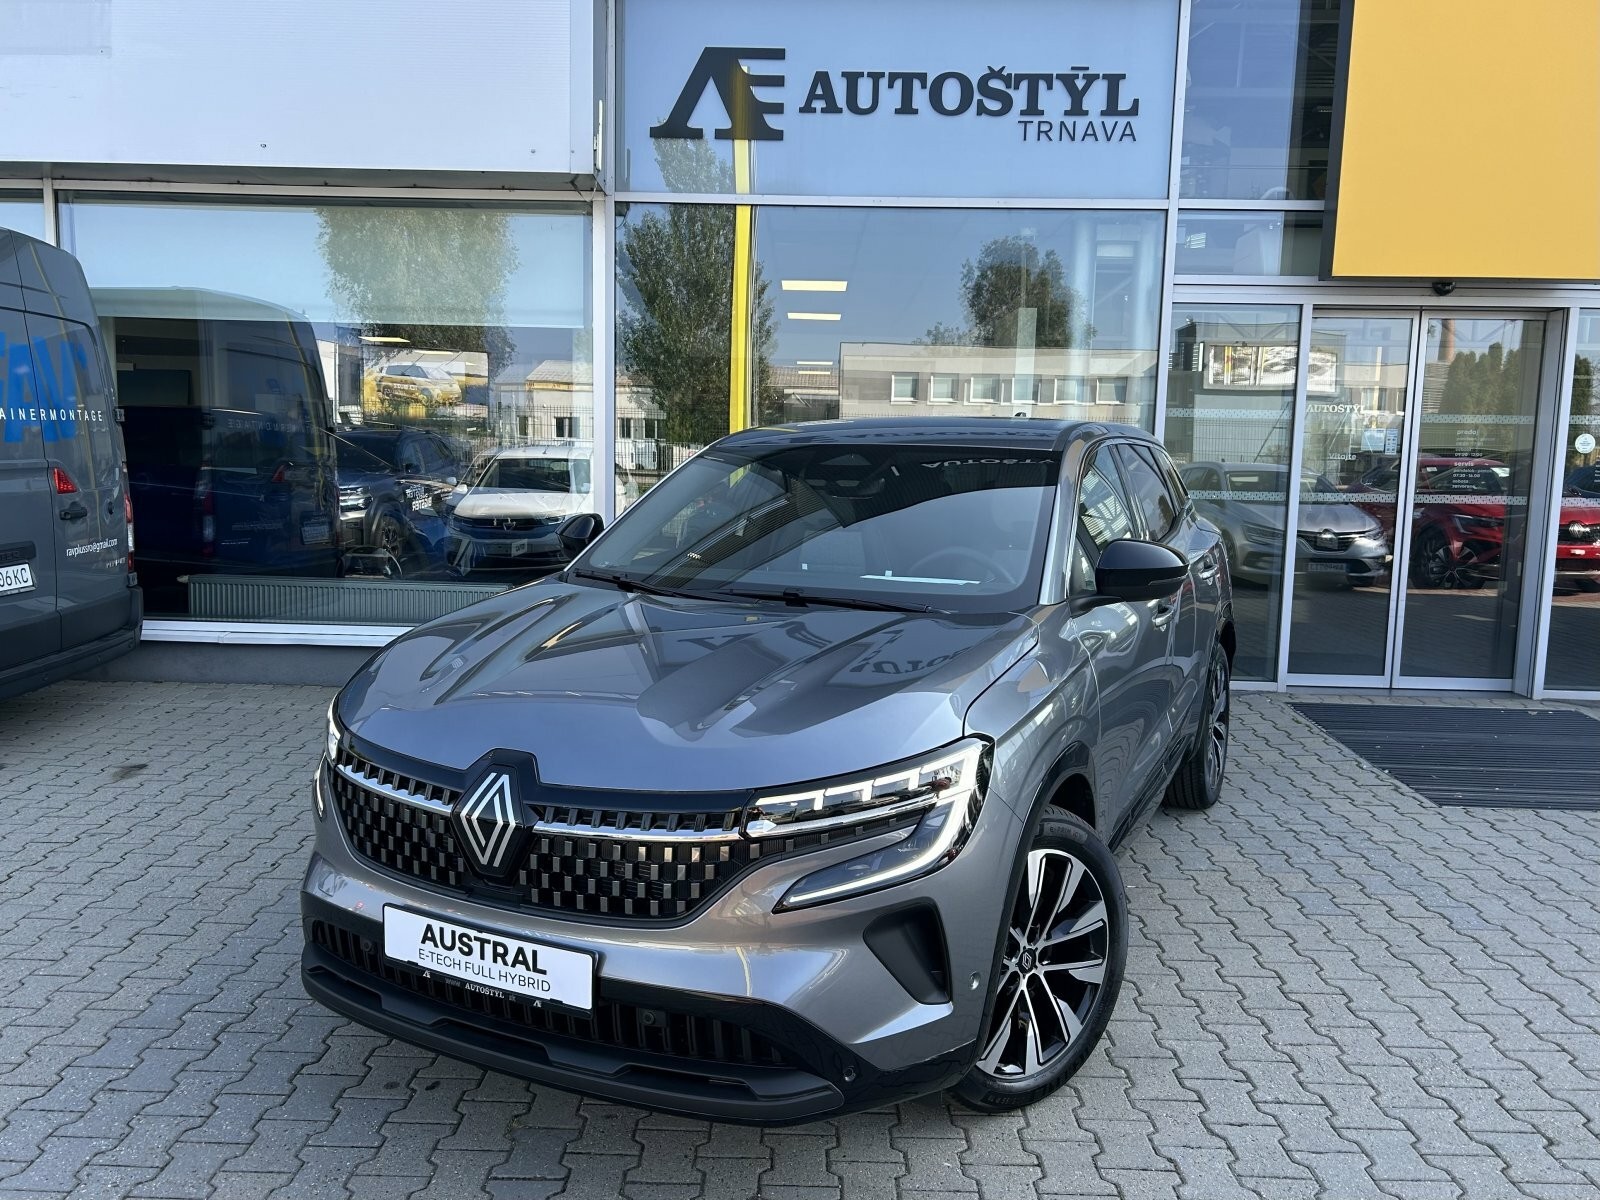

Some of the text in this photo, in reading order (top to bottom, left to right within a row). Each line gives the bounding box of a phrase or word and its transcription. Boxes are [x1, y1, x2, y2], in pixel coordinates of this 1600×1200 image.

[1018, 120, 1137, 142] TRNAVA
[418, 948, 551, 992] E-TECH FULL HYBRID
[420, 923, 548, 975] AUSTRAL
